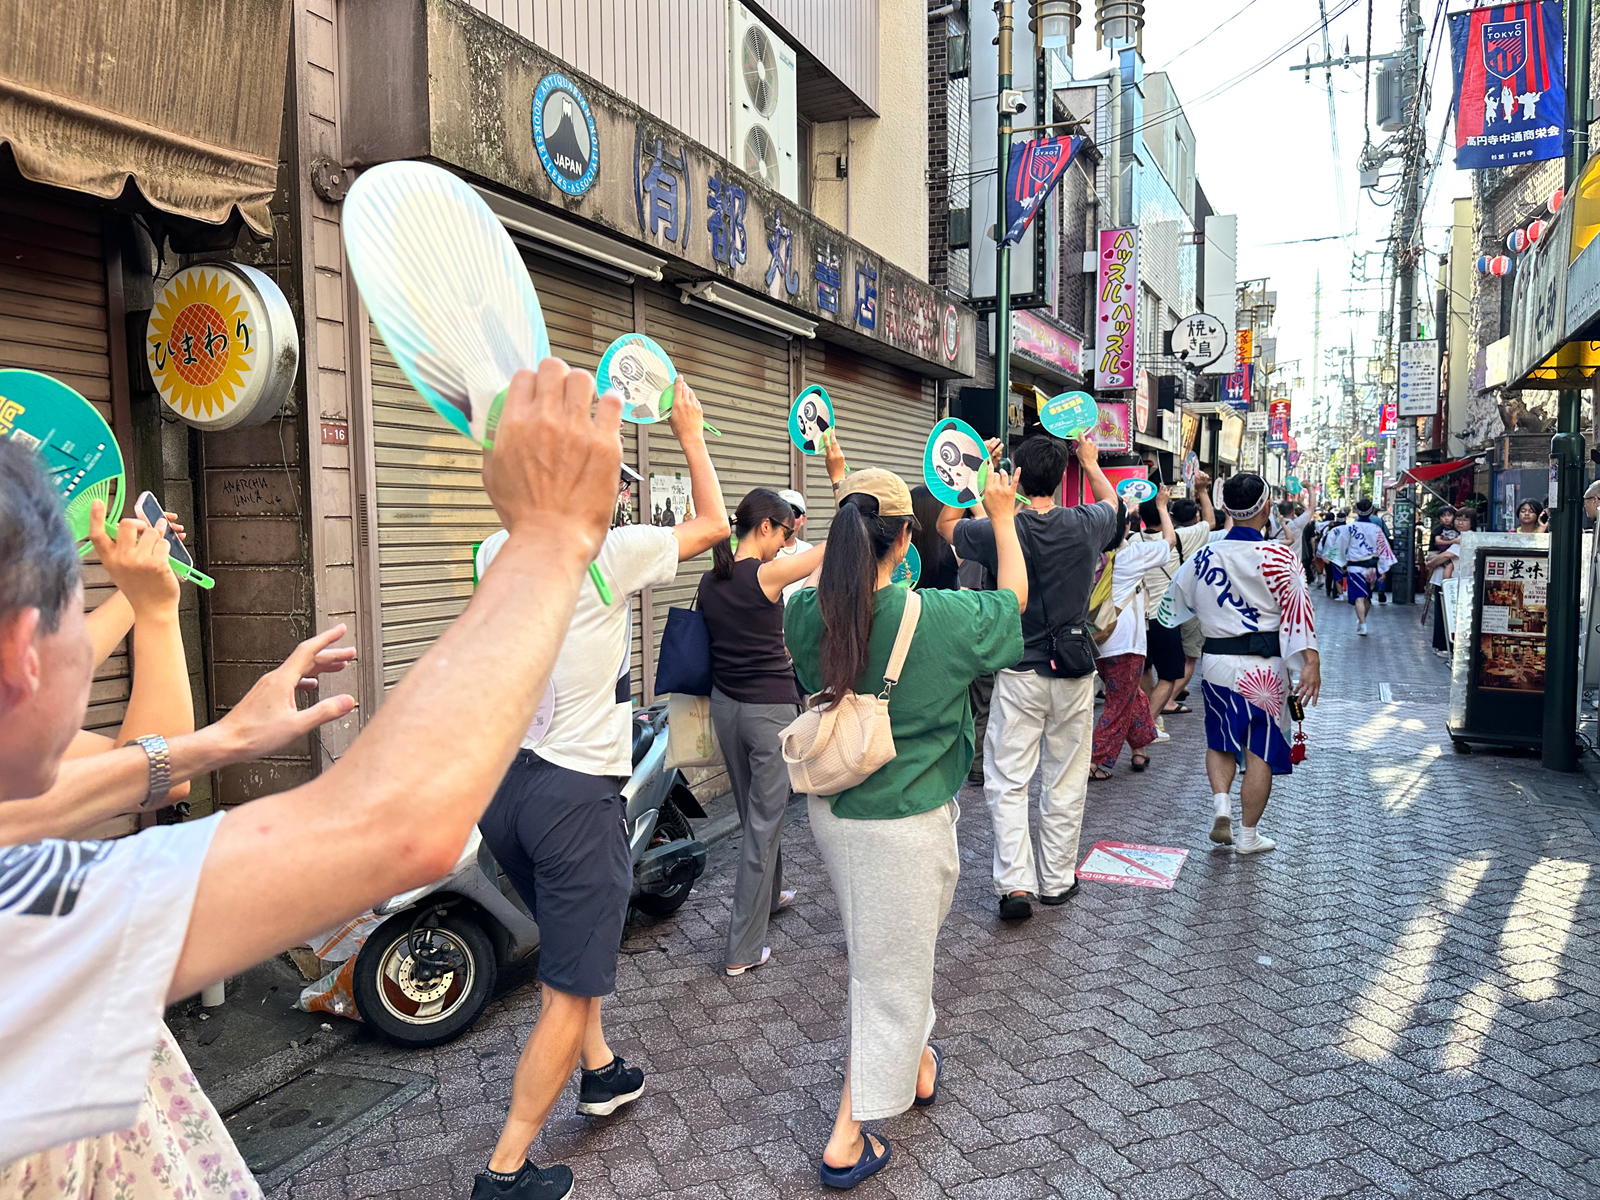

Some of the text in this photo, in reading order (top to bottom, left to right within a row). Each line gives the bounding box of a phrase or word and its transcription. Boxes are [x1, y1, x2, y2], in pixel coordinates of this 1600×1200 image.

[1487, 30, 1522, 39] TOKYO
[539, 74, 591, 118] ANTIQUARIAN
[533, 97, 568, 190] BOOKSELLERS
[1466, 125, 1560, 147] 高円寺中通商栄会
[553, 153, 582, 176] JAPAN
[570, 125, 599, 193] ASSOCIATION
[1101, 231, 1135, 374] ハッスルハッスル
[153, 317, 249, 371] ひまわり
[1187, 320, 1212, 358] 焼き鳥
[1109, 376, 1121, 385] 2F
[322, 428, 345, 440] 1-16
[1093, 424, 1125, 441] ハッスル
